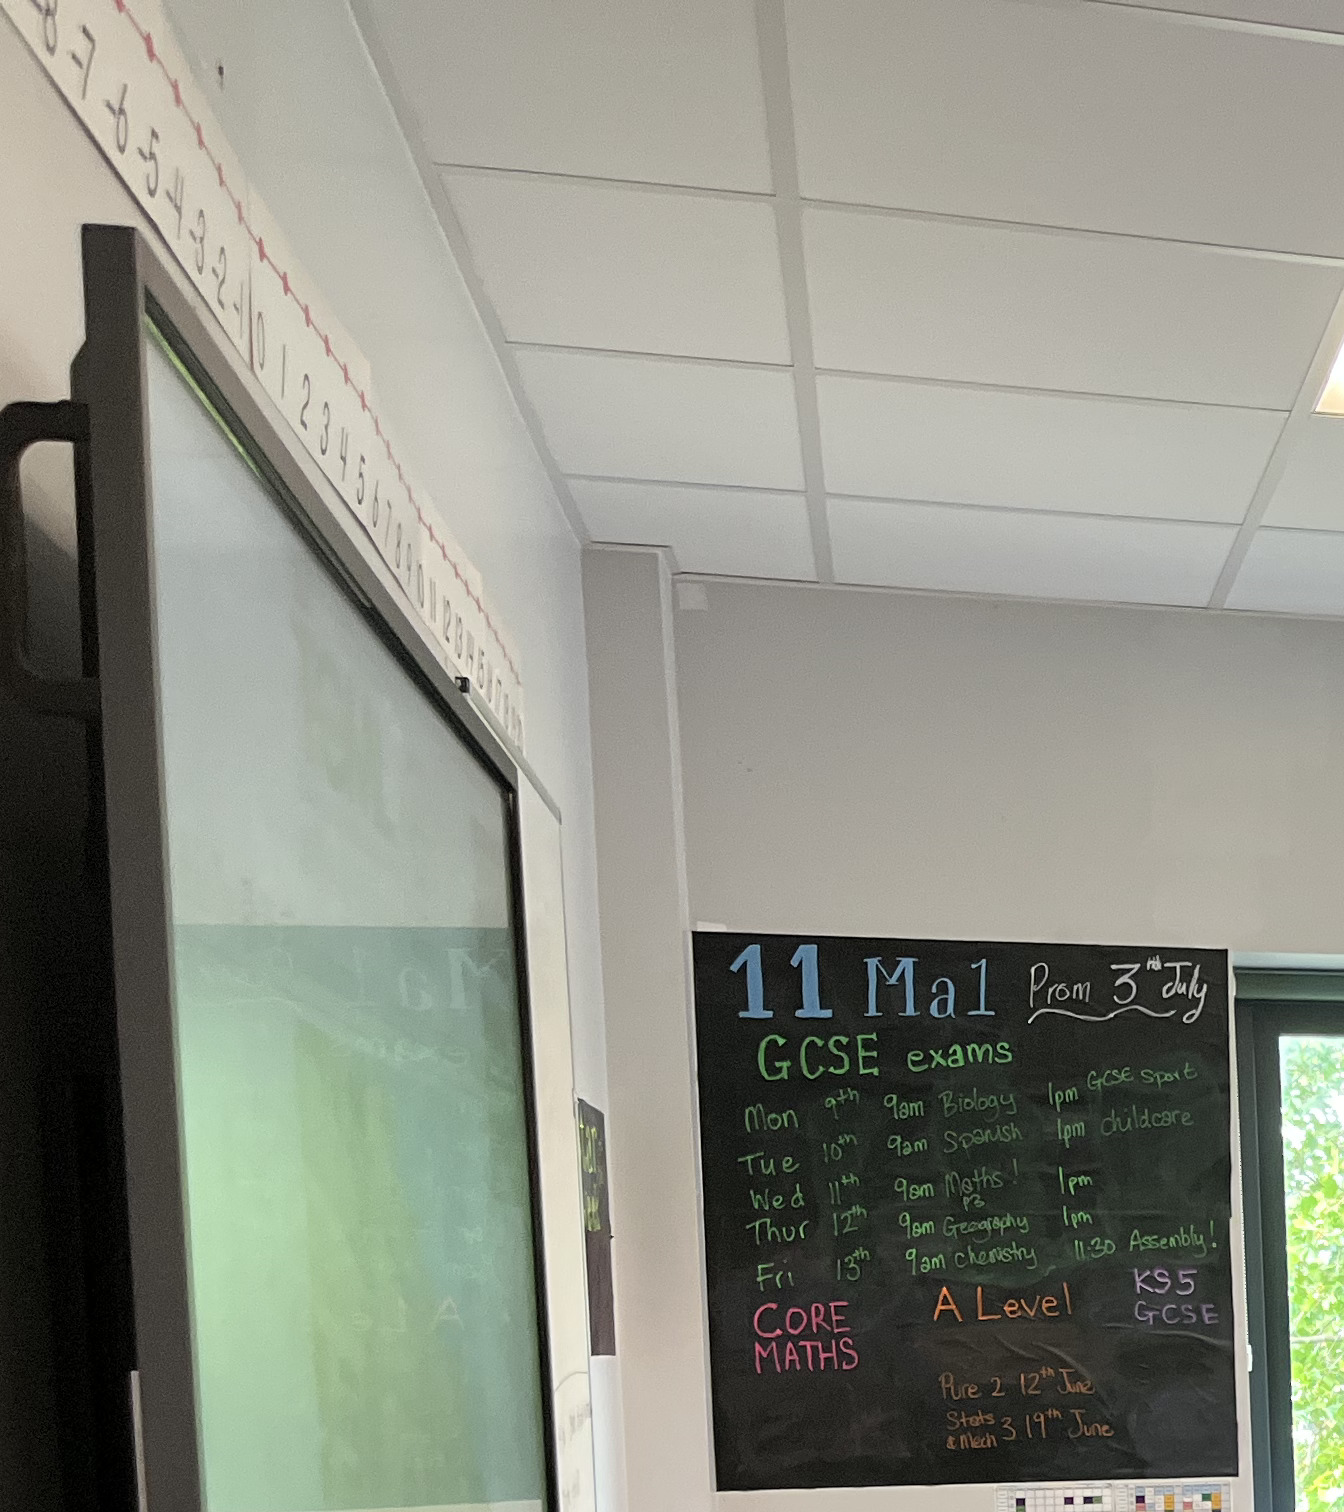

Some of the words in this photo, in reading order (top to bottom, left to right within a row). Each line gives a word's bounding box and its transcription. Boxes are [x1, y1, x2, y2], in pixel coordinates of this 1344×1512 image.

[71, 24, 96, 101] -7
[105, 83, 128, 155] -6
[137, 126, 160, 198] -5
[300, 373, 311, 431] 2
[320, 401, 331, 456] 3
[340, 426, 349, 482] 4
[357, 453, 366, 506] 5
[729, 944, 833, 1019] 11
[1029, 962, 1091, 1008] Prom
[1162, 961, 1208, 1024] July
[758, 1032, 879, 1081] GCSE
[907, 1042, 1013, 1072] exams
[745, 1103, 799, 1133] Mon
[825, 1088, 860, 1120] 9th
[884, 1094, 924, 1119] 9am
[938, 1087, 1017, 1123] Biology
[1048, 1082, 1079, 1112] 1pm
[1087, 1066, 1135, 1091] GCSE
[738, 1152, 800, 1176] Tue
[823, 1133, 858, 1163] 10th
[887, 1135, 927, 1156] 9am
[944, 1122, 1023, 1156] Spanish
[1057, 1118, 1085, 1148] 1pm
[750, 1184, 804, 1210] Wed
[895, 1178, 934, 1201] 9am
[1059, 1167, 1093, 1195] 1pm
[746, 1218, 809, 1245] Thur
[833, 1204, 868, 1237] 12th
[899, 1212, 935, 1239] 9am
[1062, 1205, 1093, 1229] 1pm
[756, 1262, 795, 1292] Fri
[906, 1248, 947, 1275] 9am
[753, 1302, 851, 1338] CORE
[933, 1286, 963, 1323] A
[976, 1281, 1072, 1321] Level
[1134, 1301, 1219, 1325] GCSE
[754, 1338, 859, 1374] MATHS
[938, 1371, 982, 1400] Pure
[991, 1377, 1006, 1397] 2
[1057, 1368, 1096, 1395] June
[1068, 1409, 1115, 1440] June
